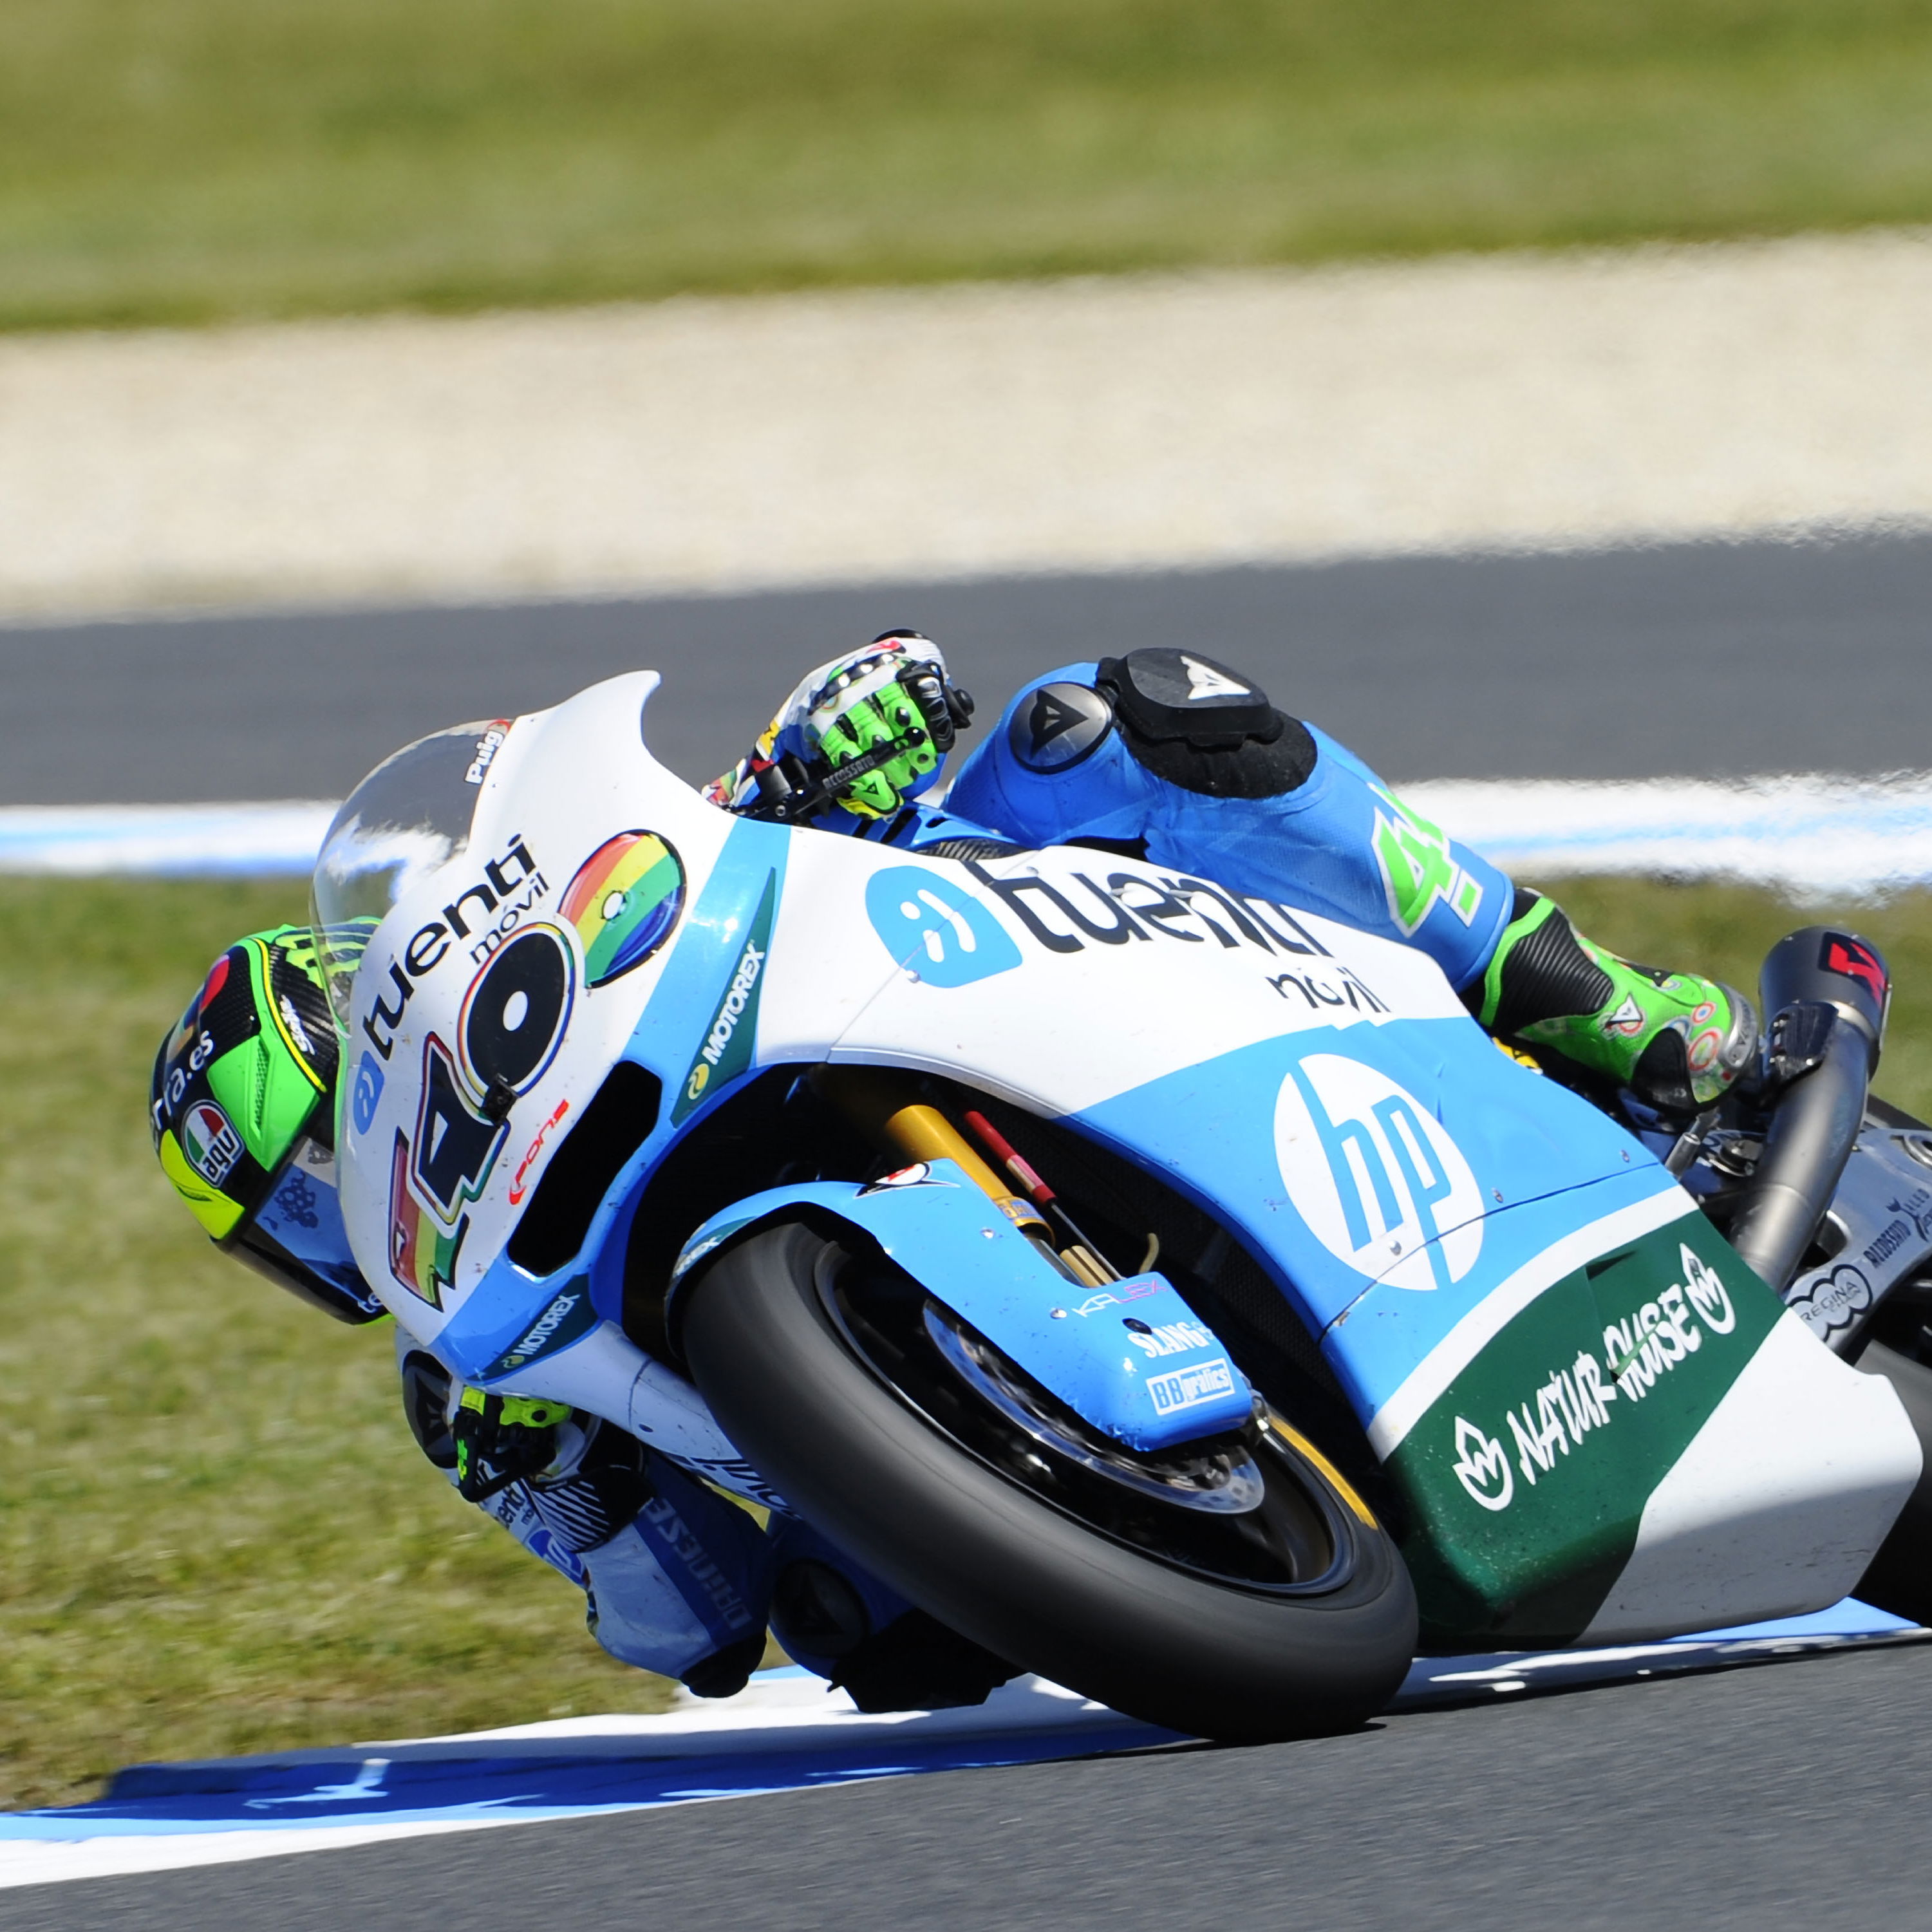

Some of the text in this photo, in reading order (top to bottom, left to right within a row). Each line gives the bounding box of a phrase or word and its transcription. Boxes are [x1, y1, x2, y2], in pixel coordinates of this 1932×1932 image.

[465, 731, 504, 783] Puig
[823, 755, 875, 789] ACCOSSATO
[363, 833, 537, 1061] tuenti
[469, 872, 550, 964] móvil
[702, 941, 765, 1065] MOTOREX
[202, 1127, 236, 1179] agv
[1290, 1055, 1454, 1290] hp
[512, 1295, 580, 1355] MOTOREX
[1071, 1279, 1167, 1317] KALEX
[1800, 1281, 1857, 1320] REGINA
[644, 1497, 752, 1629] DAINESE
